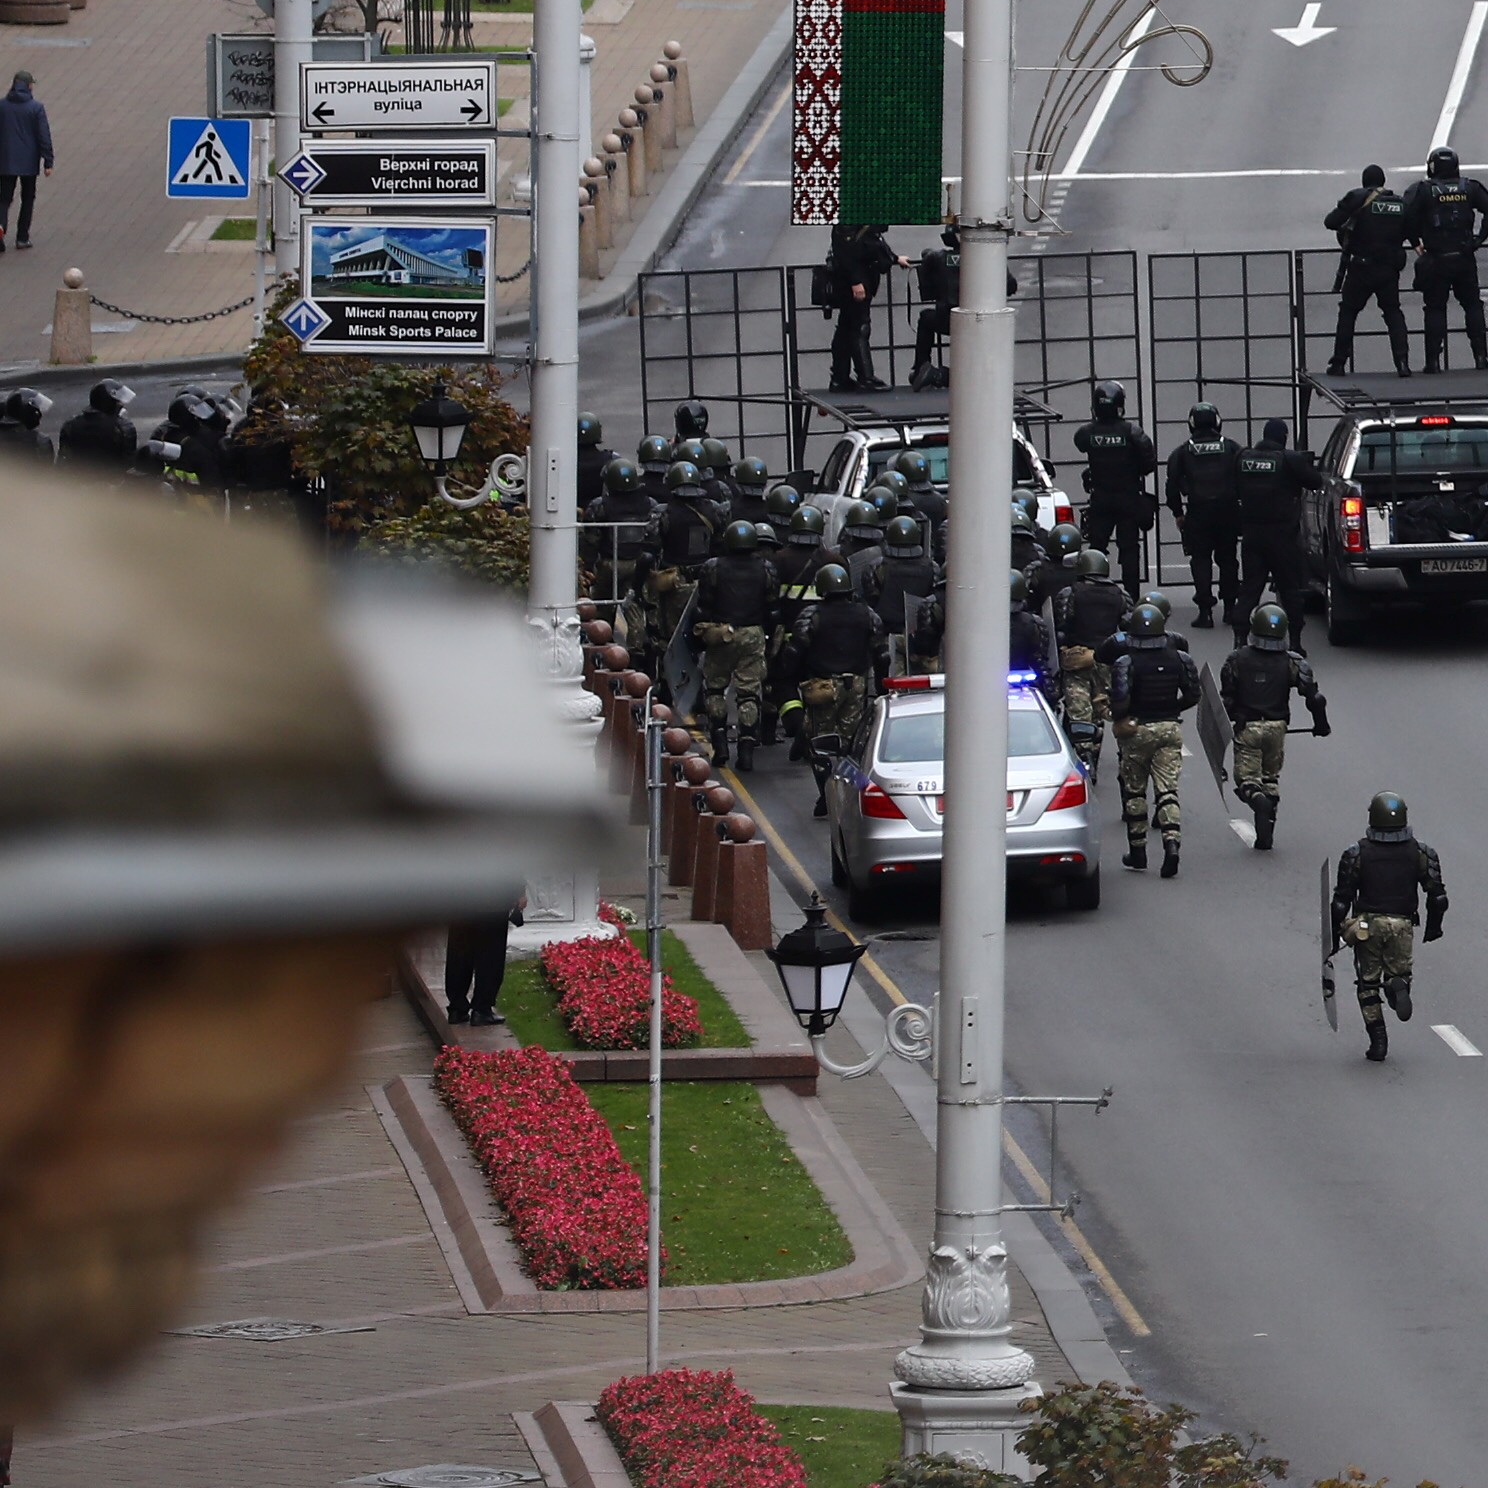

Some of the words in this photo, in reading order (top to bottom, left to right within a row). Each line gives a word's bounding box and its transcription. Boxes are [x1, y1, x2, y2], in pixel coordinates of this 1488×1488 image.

[314, 79, 484, 95] ІНТЭРНАЦЫЯНАЛЬНАЯ
[374, 98, 422, 113] вуліца
[380, 158, 430, 173] Верхні
[434, 160, 478, 173] горад
[371, 177, 431, 189] Vierchni
[436, 176, 478, 189] horad
[1439, 194, 1467, 202] ОМОН
[345, 306, 385, 318] Мінскі
[389, 309, 428, 320] палац
[432, 310, 478, 322] спорту
[348, 325, 386, 336] Minsk
[389, 325, 431, 339] Sports
[435, 326, 478, 338] Palace
[917, 780, 937, 792] 679
